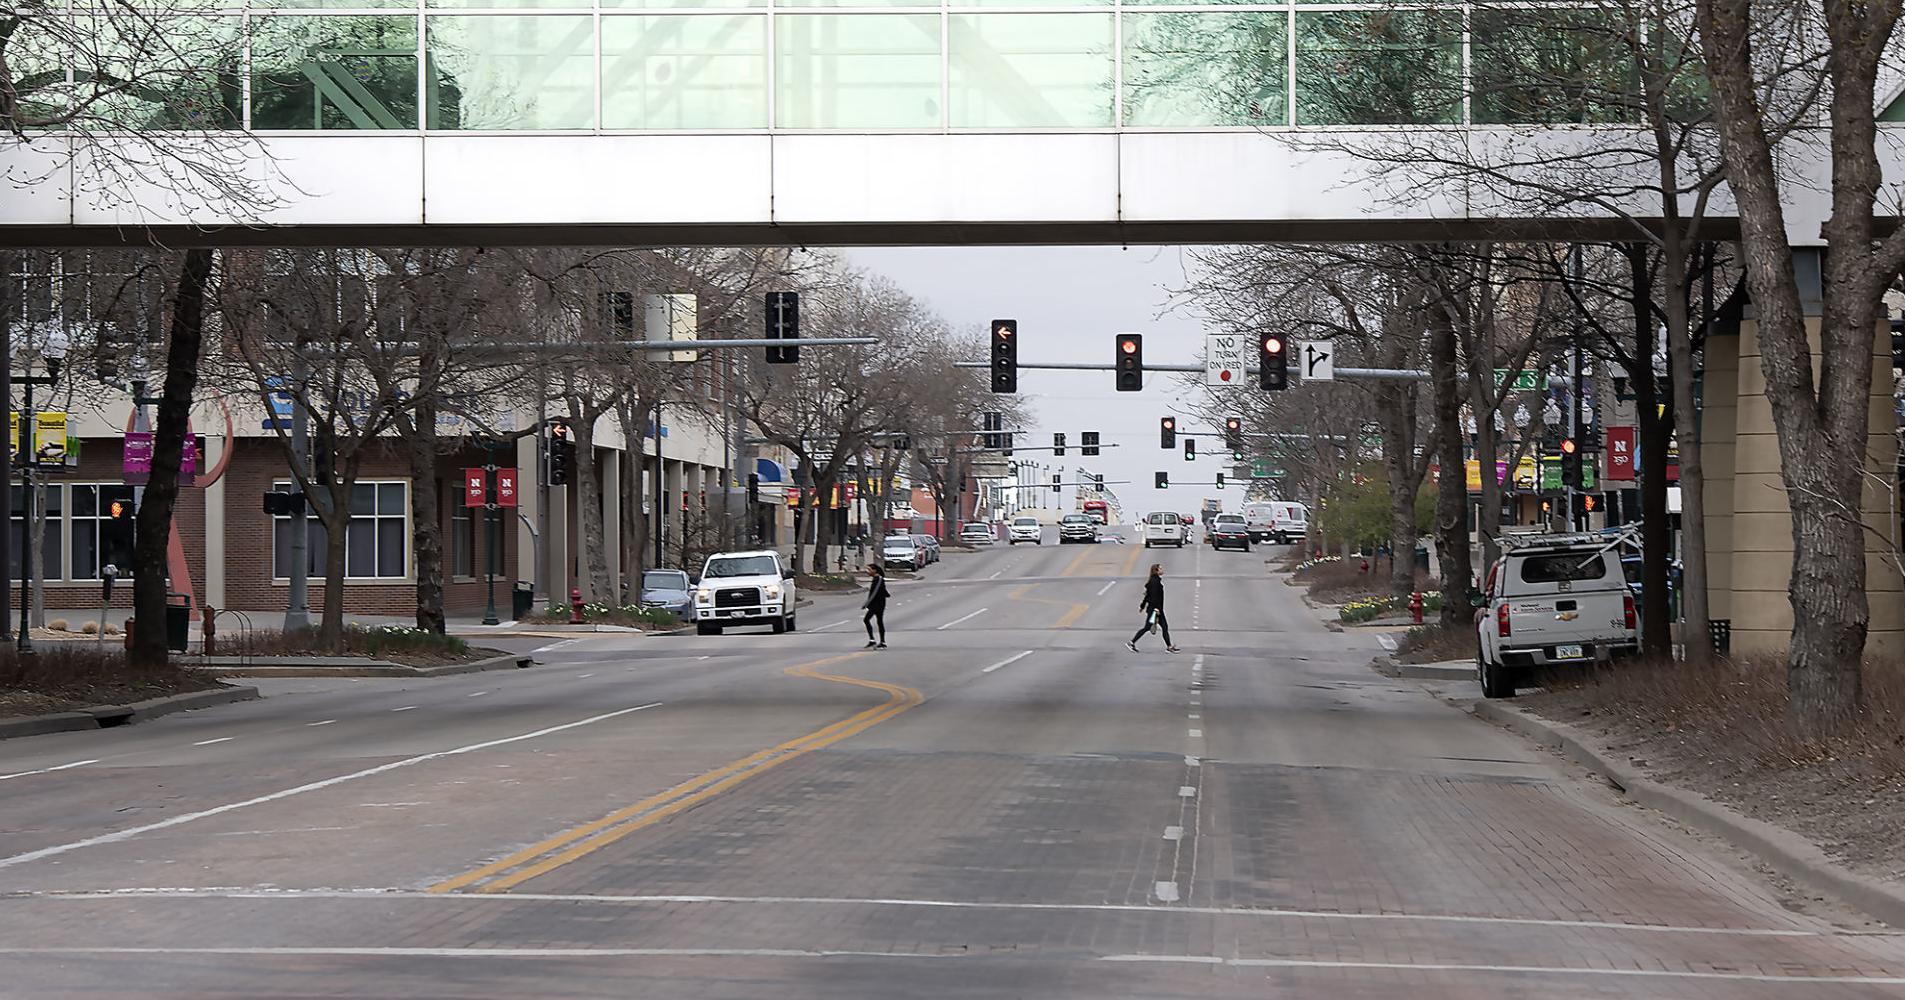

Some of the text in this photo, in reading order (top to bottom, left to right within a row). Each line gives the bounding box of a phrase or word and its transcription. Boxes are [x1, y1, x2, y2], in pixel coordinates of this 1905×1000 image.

[1216, 337, 1235, 349] NO
[1215, 350, 1239, 359] TURN
[1210, 360, 1242, 370] ON RED
[1614, 440, 1627, 452] N
[471, 478, 481, 488] N
[502, 478, 512, 488] N
